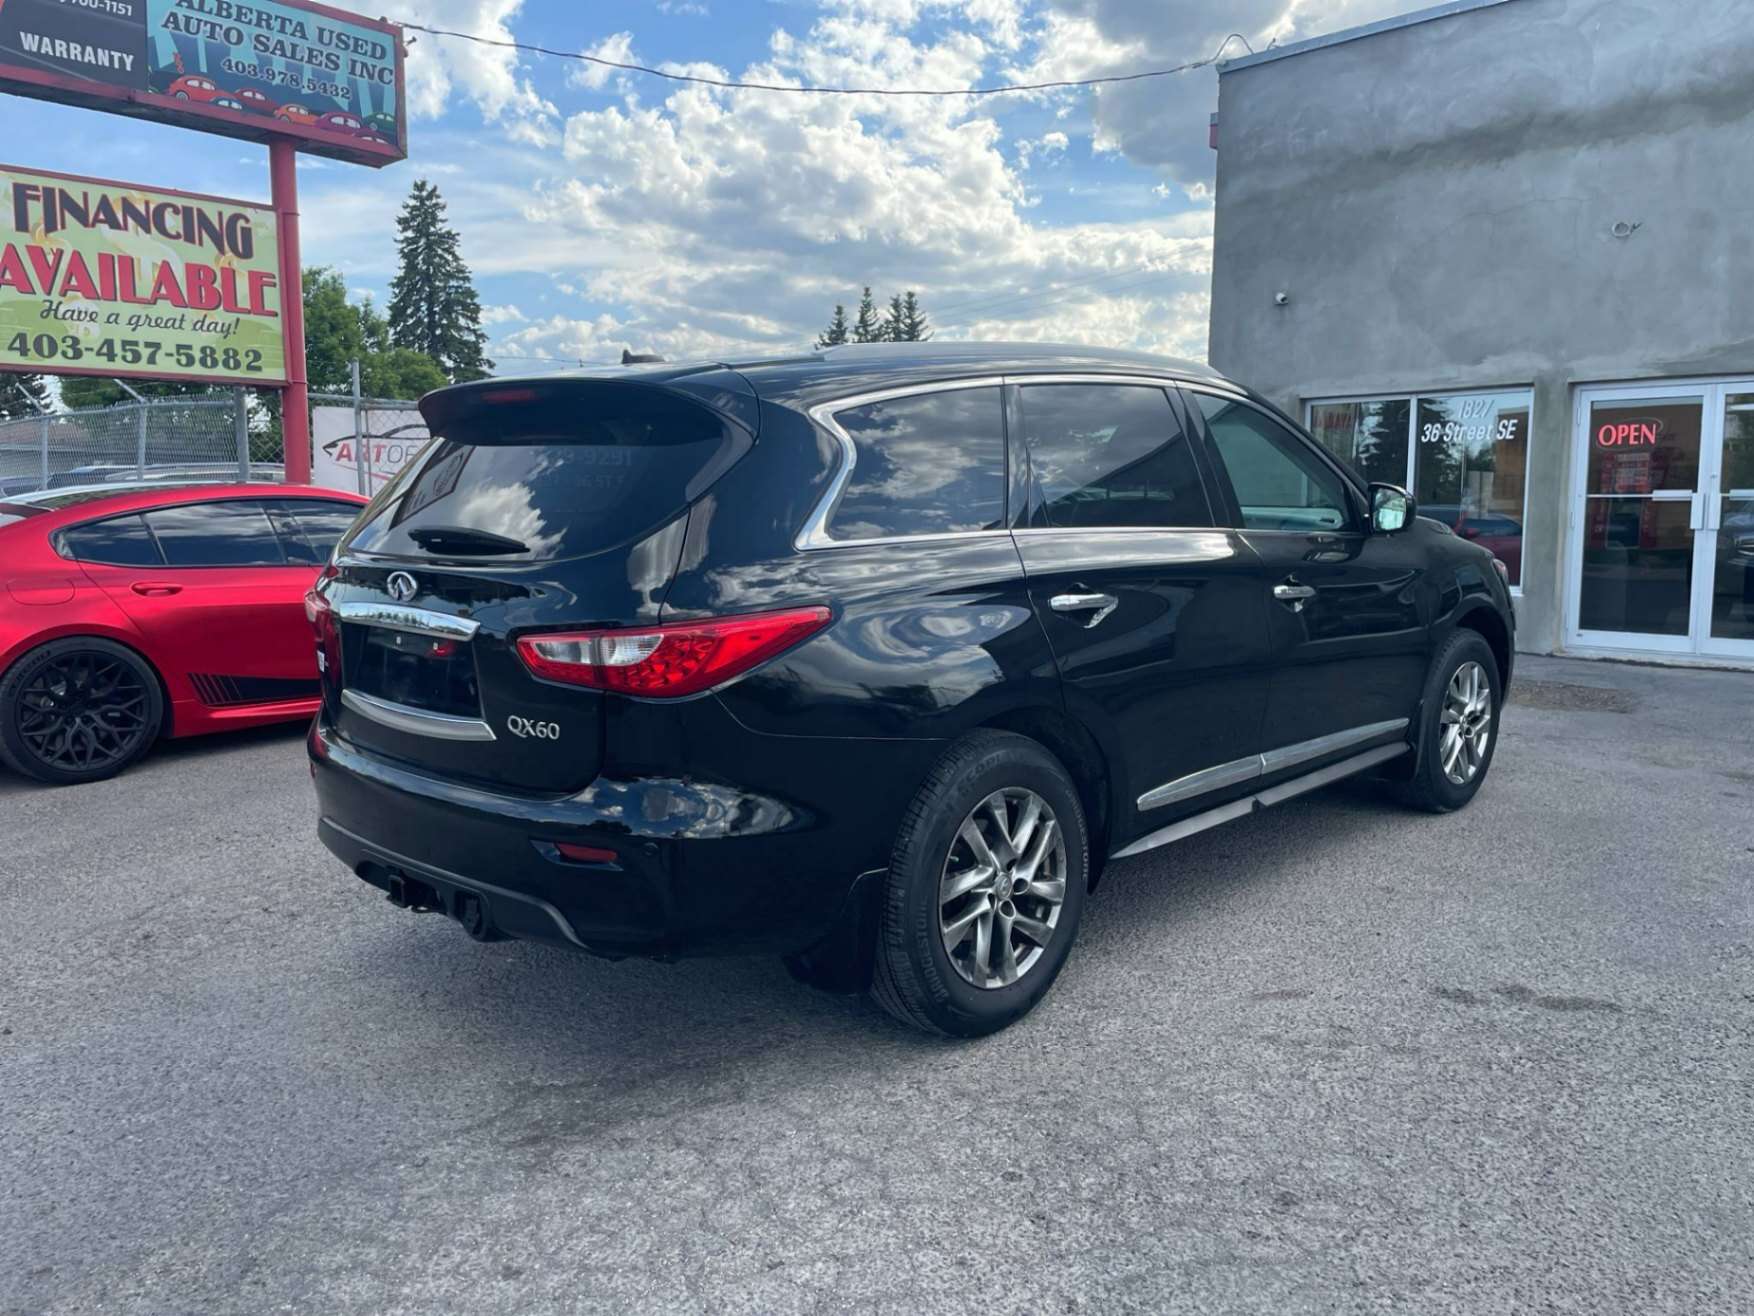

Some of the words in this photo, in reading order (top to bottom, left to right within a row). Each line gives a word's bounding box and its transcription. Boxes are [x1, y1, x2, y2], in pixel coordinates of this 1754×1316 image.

[19, 31, 134, 71] WARRANTY
[161, 11, 244, 46] AUTO
[253, 34, 341, 72] SALES
[348, 55, 394, 85] INC
[317, 28, 387, 62] USED
[222, 58, 351, 100] 403.978.5432
[12, 182, 253, 259] FINANCING
[0, 243, 278, 317] AVAILABLE
[40, 299, 98, 323] Have
[104, 312, 120, 325] a
[128, 313, 186, 333] great
[192, 317, 240, 340] day!
[8, 332, 263, 372] 403-457-5882
[1421, 422, 1441, 443] 36
[1443, 420, 1493, 442] Street
[1496, 419, 1518, 441] SE
[1598, 423, 1657, 446] OPEN
[507, 715, 561, 740] QX60
